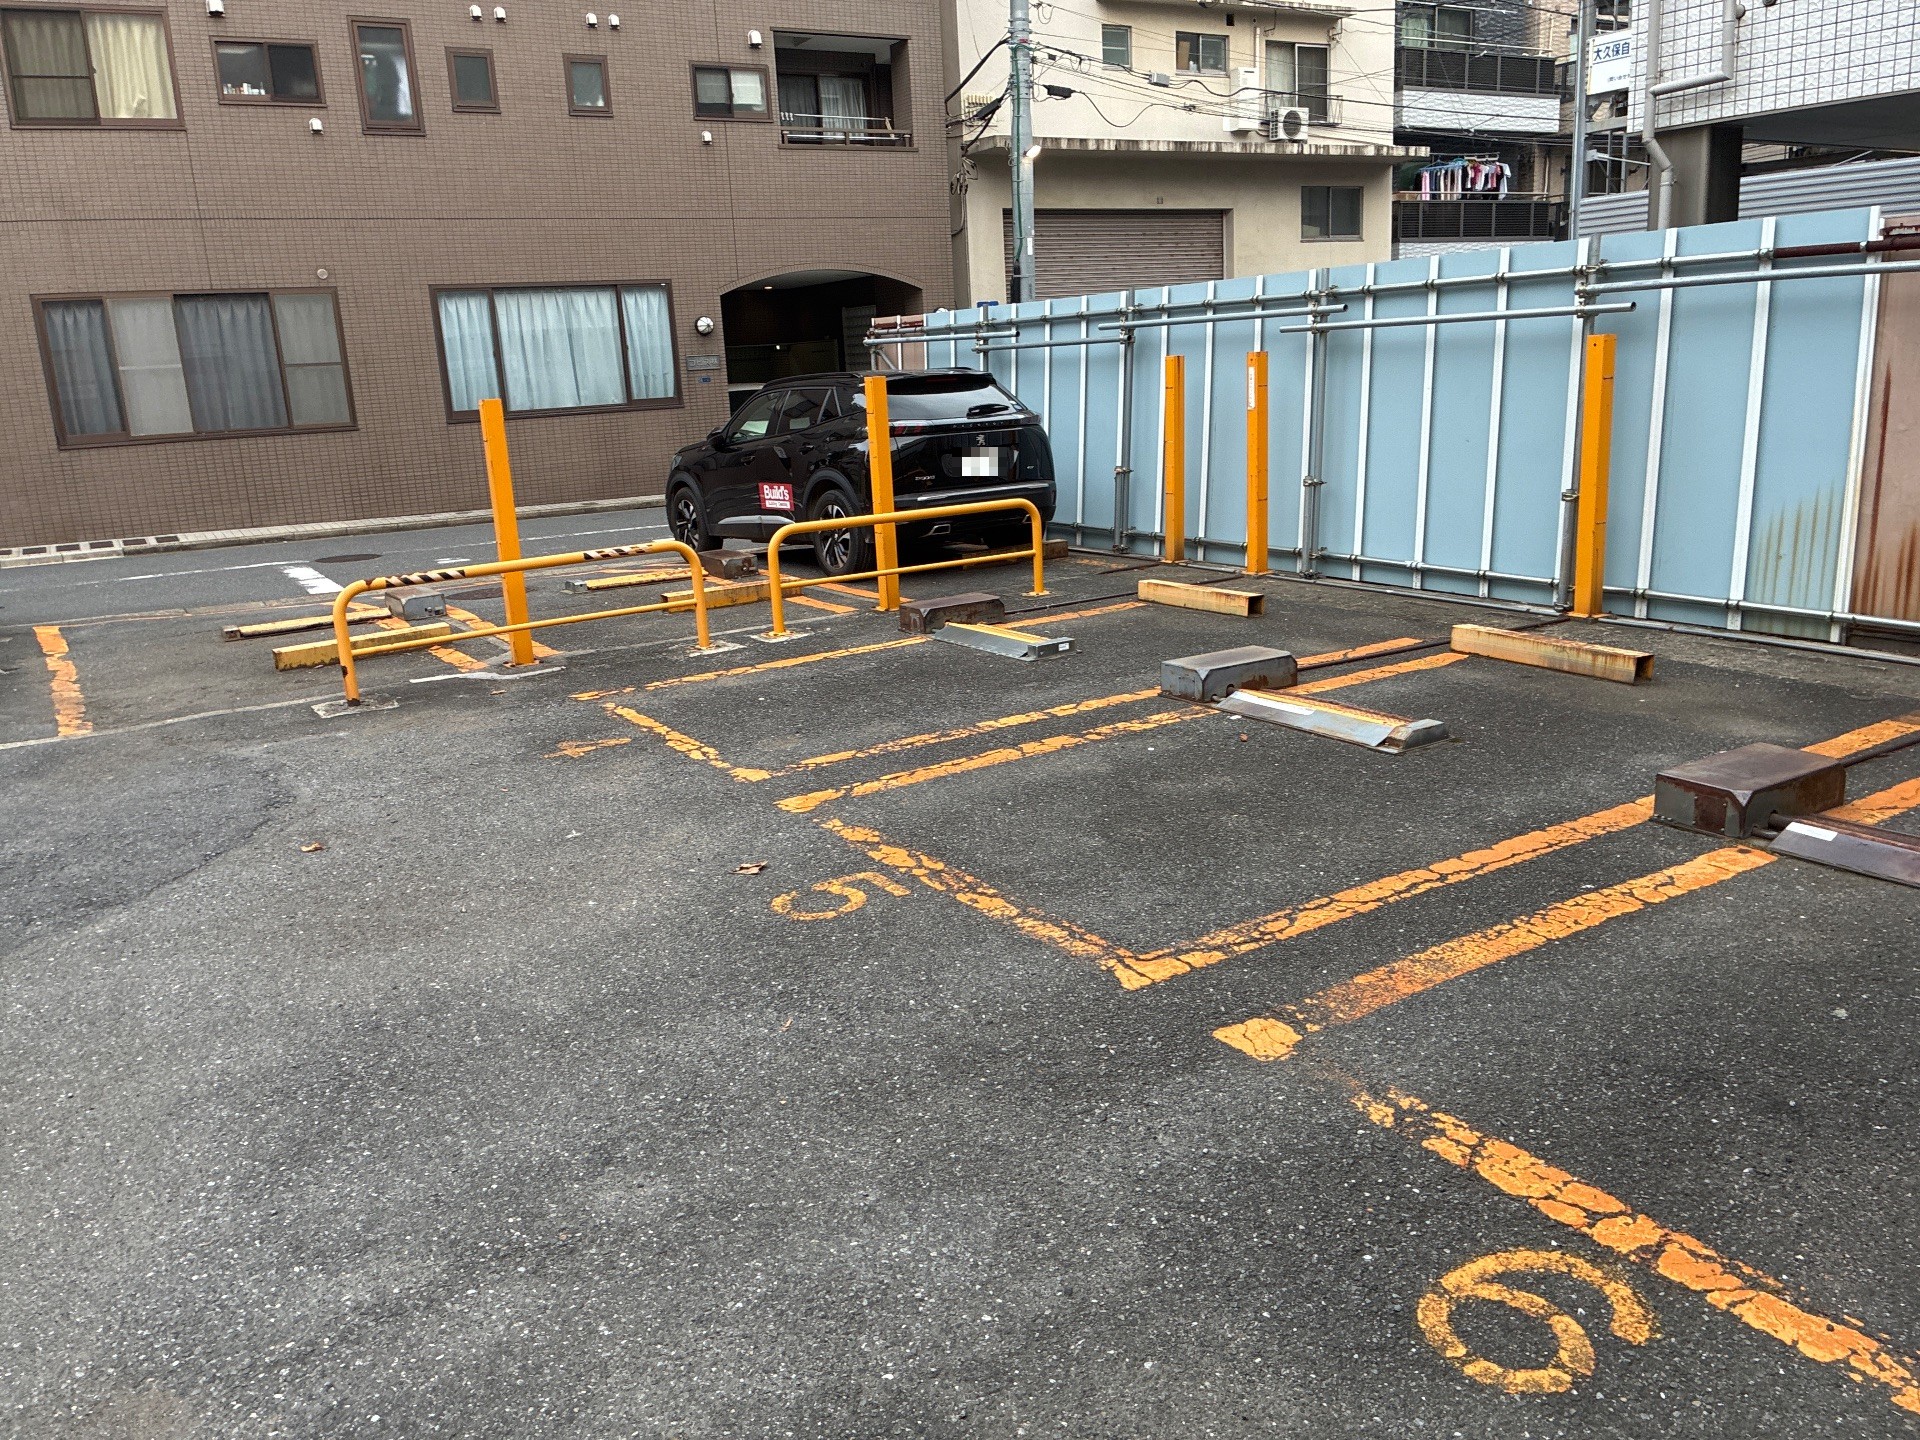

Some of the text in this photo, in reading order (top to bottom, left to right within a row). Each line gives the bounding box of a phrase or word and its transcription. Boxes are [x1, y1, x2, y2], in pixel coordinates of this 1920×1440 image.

[1594, 41, 1630, 61] 大久保自
[763, 484, 790, 501] Build's
[771, 871, 912, 921] 5
[1417, 1249, 1654, 1394] 6
